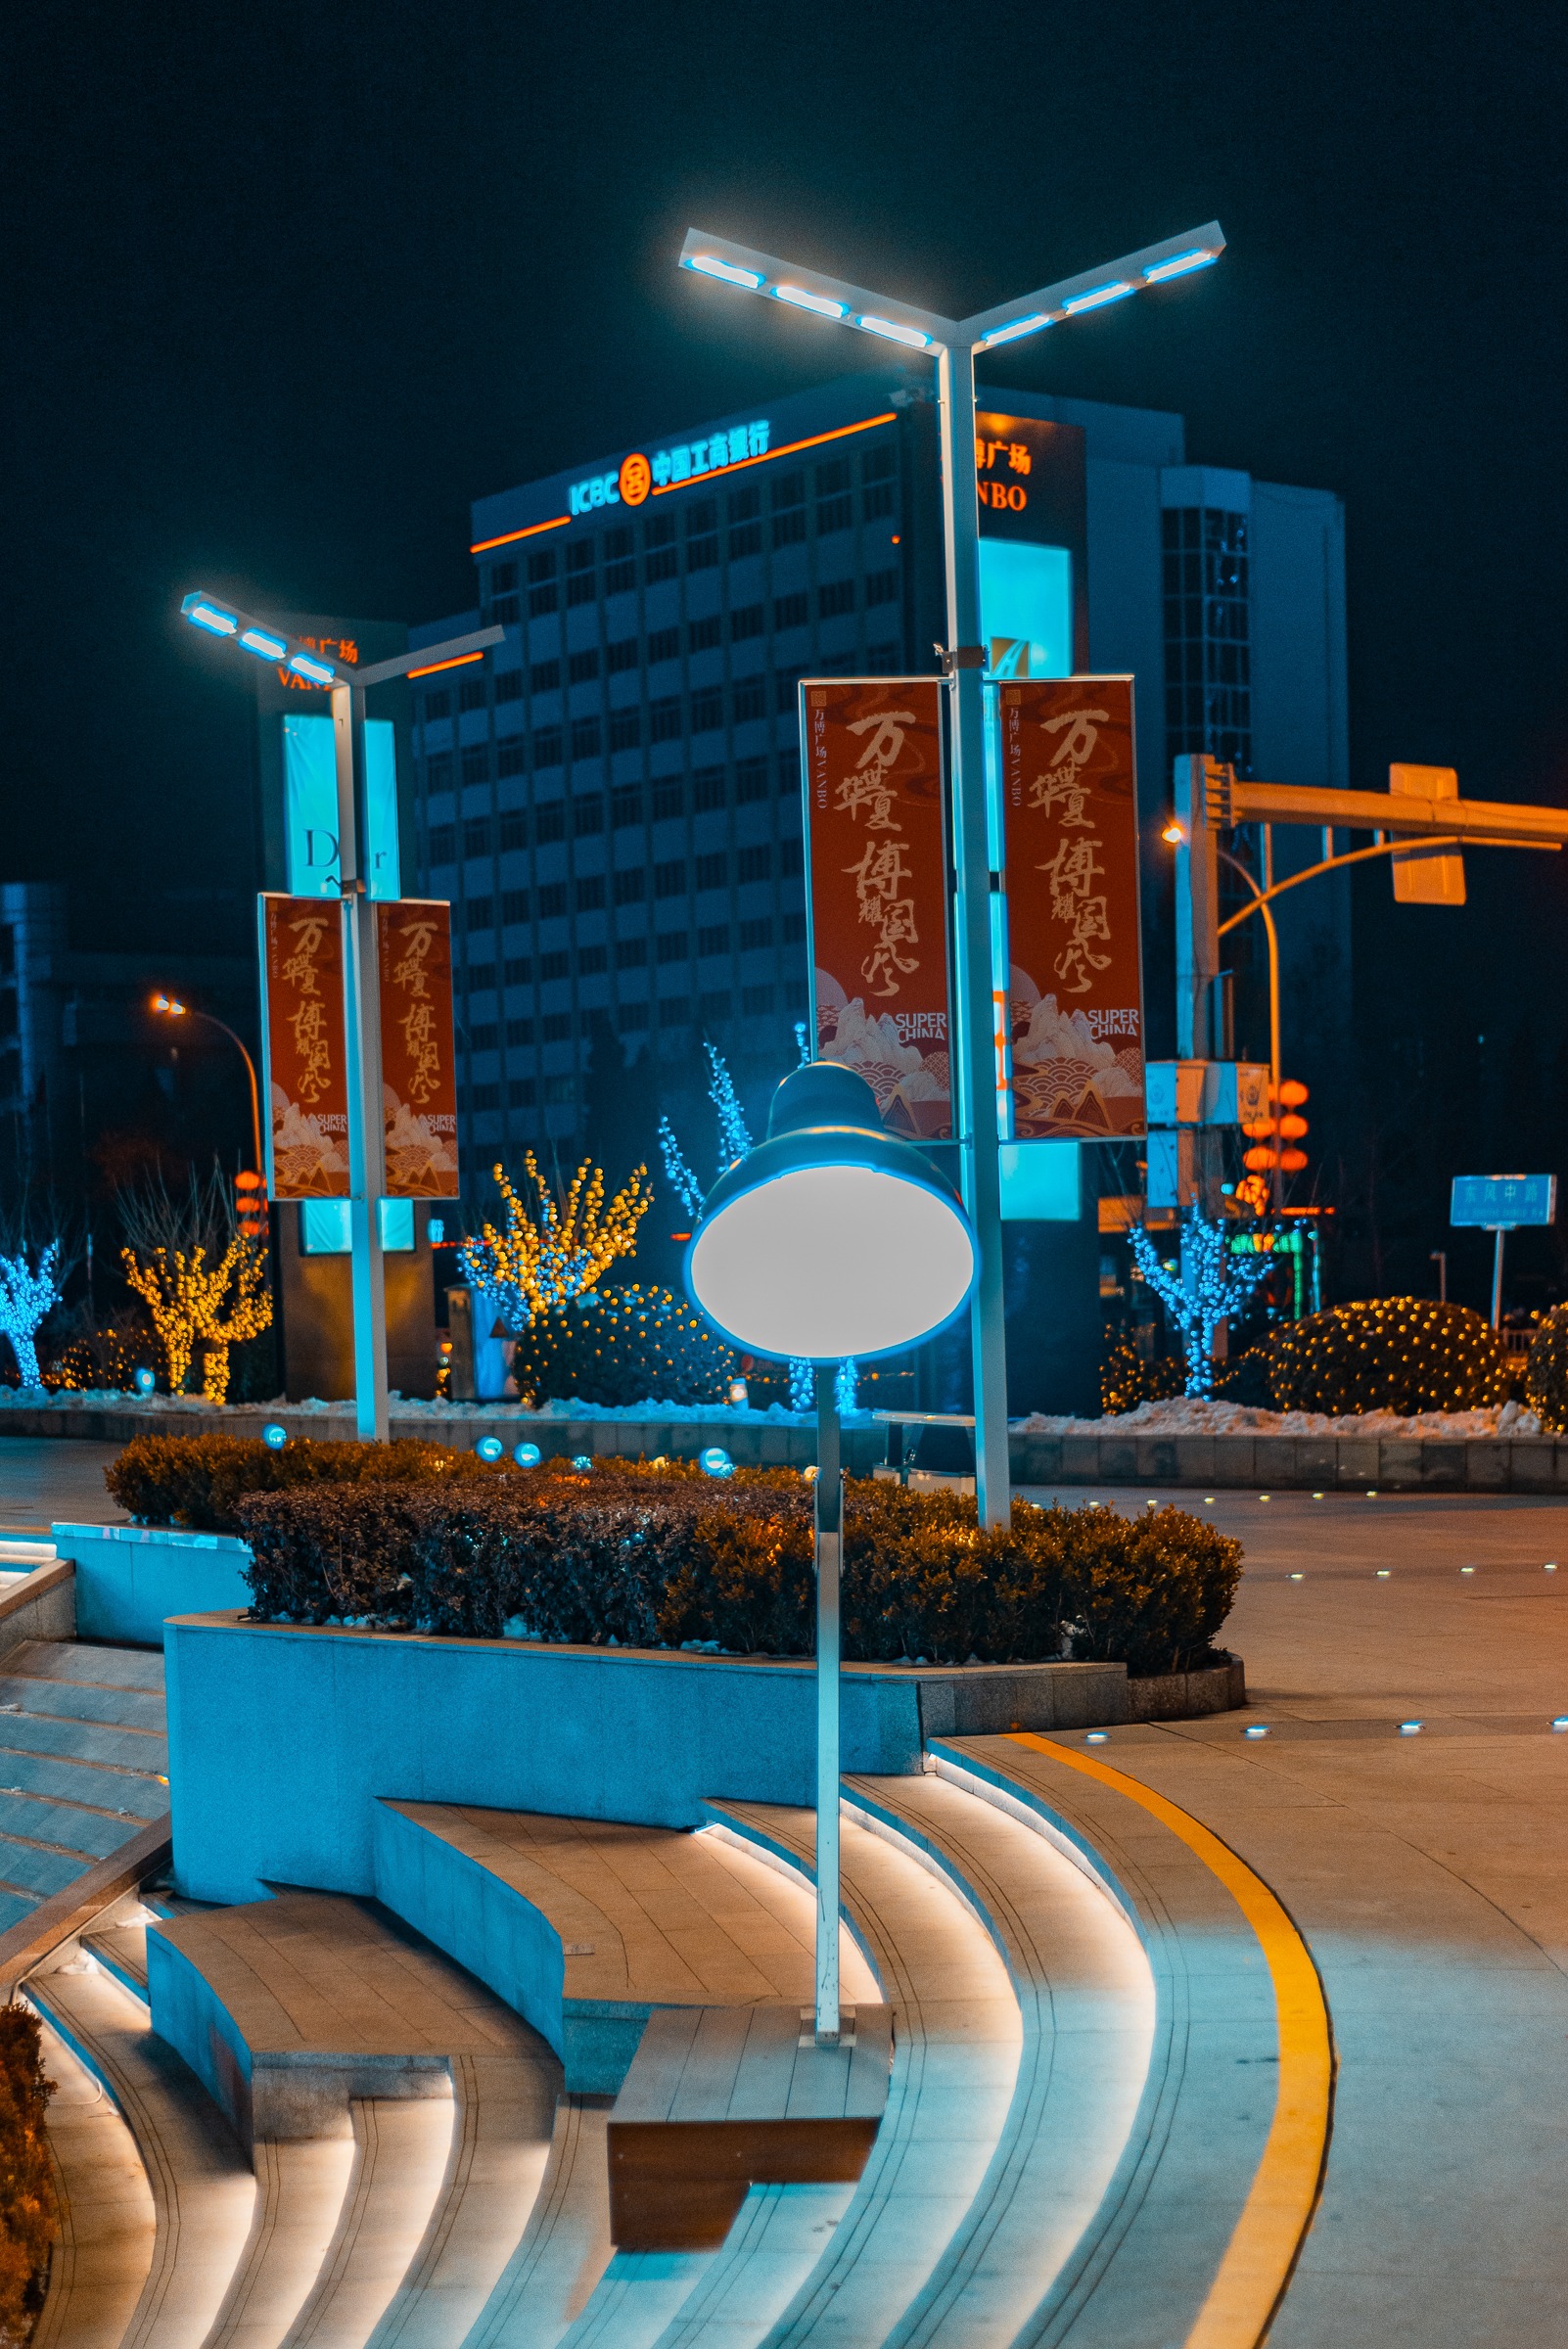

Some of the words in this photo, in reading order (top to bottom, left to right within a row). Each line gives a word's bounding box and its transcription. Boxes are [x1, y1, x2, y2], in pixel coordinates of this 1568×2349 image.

[651, 419, 770, 487] 中国工商银行
[569, 470, 621, 516] ICBC
[895, 1012, 947, 1029] SUPER
[1087, 1008, 1140, 1027] SUPER
[898, 1027, 945, 1044] CHINA
[1089, 1024, 1138, 1040] CHINA
[316, 1114, 347, 1125] SUPER
[427, 1114, 456, 1125] SUPER
